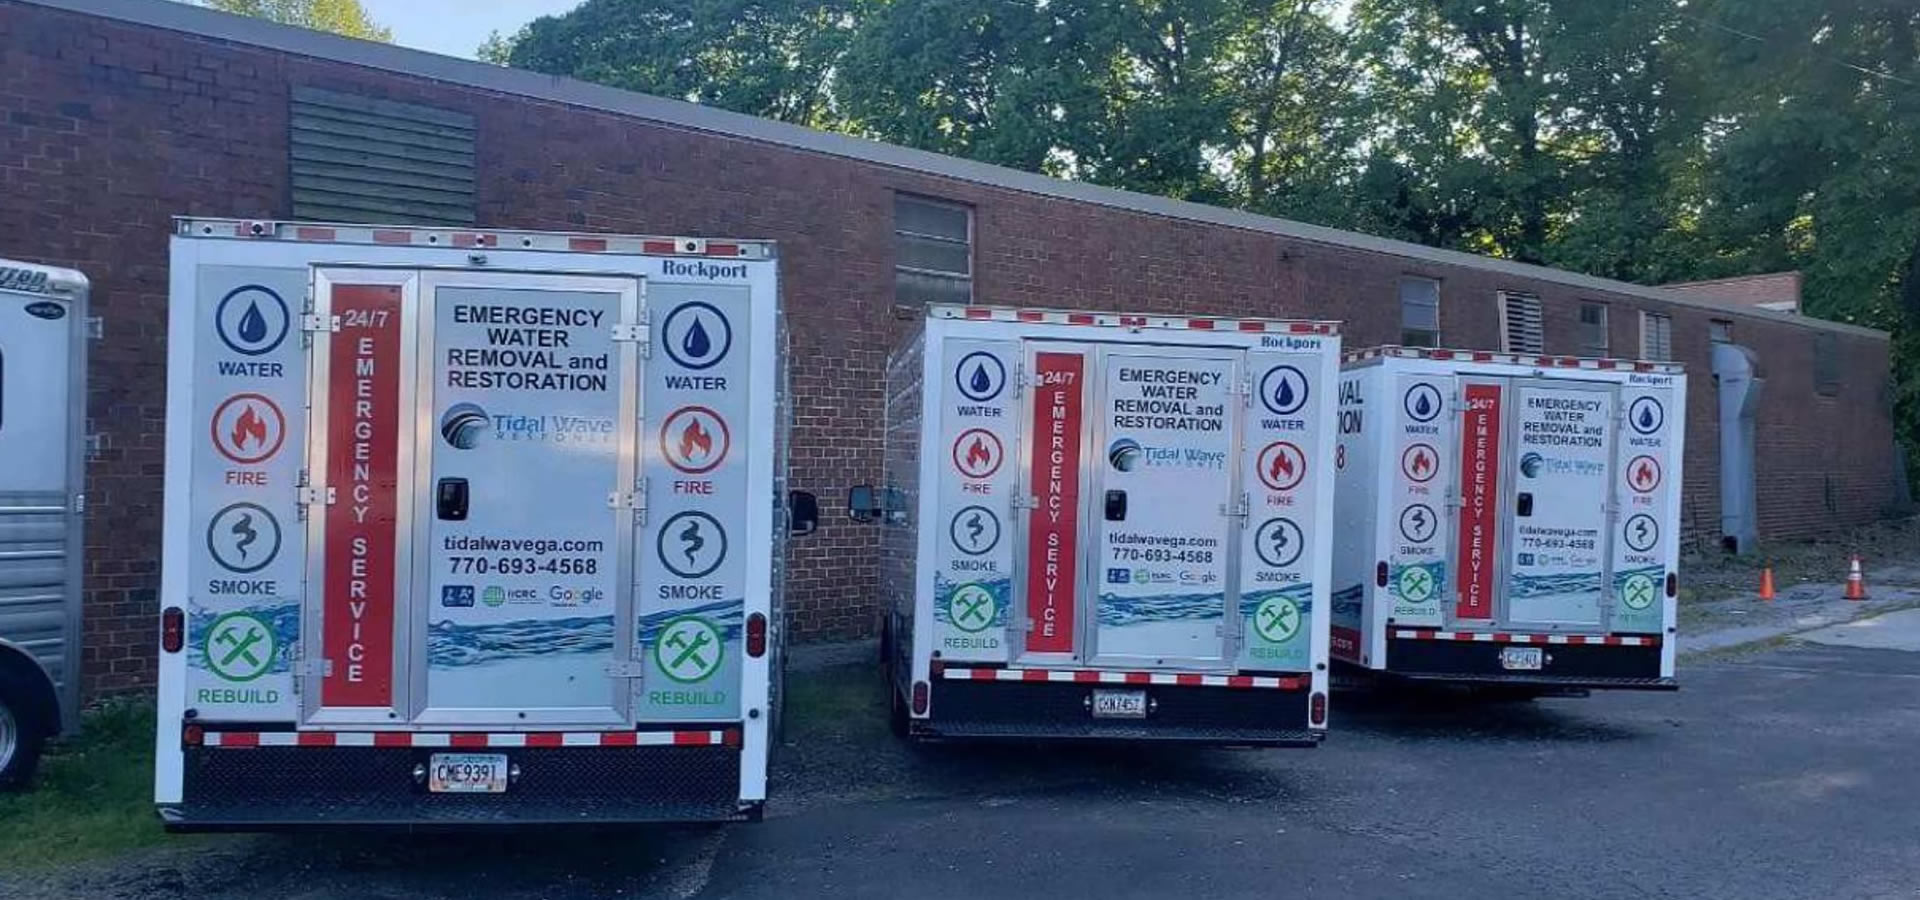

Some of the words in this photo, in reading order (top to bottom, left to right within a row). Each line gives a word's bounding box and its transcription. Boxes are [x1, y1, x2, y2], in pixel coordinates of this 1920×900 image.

[662, 260, 748, 280] Rockport
[344, 308, 389, 328] 24/7
[453, 304, 604, 328] EMERGENCY
[487, 328, 569, 347] WATER
[1261, 336, 1322, 350] Rockport
[447, 348, 562, 369] REMOVAL
[568, 353, 608, 371] and
[218, 361, 284, 378] WATER
[1119, 368, 1222, 385] EMERGENCY
[447, 370, 607, 391] RESTORATION
[665, 375, 727, 390] WATER
[1045, 371, 1075, 385] 24/7
[1141, 385, 1198, 399] WATER
[957, 406, 1002, 417] WATER
[1114, 400, 1191, 414] REMOVAL
[1196, 403, 1223, 416] and
[1528, 397, 1602, 411] EMERGENCY
[492, 415, 546, 432] Tidal
[552, 415, 613, 433] Wave
[1114, 415, 1222, 431] RESTORATION
[1544, 411, 1585, 422] WATER
[353, 337, 374, 524] EMERGENCY
[1261, 419, 1305, 430] WATER
[1405, 424, 1439, 435] WATER
[1524, 422, 1580, 434] REMOVAL
[1584, 425, 1603, 436] and
[1523, 434, 1602, 447] RESTORATION
[1630, 437, 1661, 448] WATER
[1049, 391, 1065, 523] EMERGENCY
[1144, 447, 1180, 460] Tidal
[1184, 448, 1226, 461] Wave
[1474, 414, 1488, 518] EMERGENCY
[225, 471, 269, 485] FIRE
[674, 480, 713, 494] FIRE
[962, 483, 991, 494] FIRE
[1266, 495, 1294, 506] FIRE
[444, 536, 603, 554] tidalwavega.com
[1109, 532, 1217, 548] tidalwavega.com
[1113, 548, 1213, 564] 770-693-4568
[449, 557, 598, 575] 770-693-4568
[951, 560, 997, 571] SMOKE
[1470, 525, 1481, 606] SERVICE
[1255, 572, 1301, 582] SMOKE
[208, 580, 277, 595] SMOKE
[658, 585, 723, 600] SMOKE
[1043, 533, 1059, 637] SERVICE
[550, 585, 603, 603] Google
[348, 538, 367, 682] SERVICE
[944, 638, 998, 649] REBUILD
[197, 689, 278, 704] REBUILD
[650, 691, 726, 705] REBUILD
